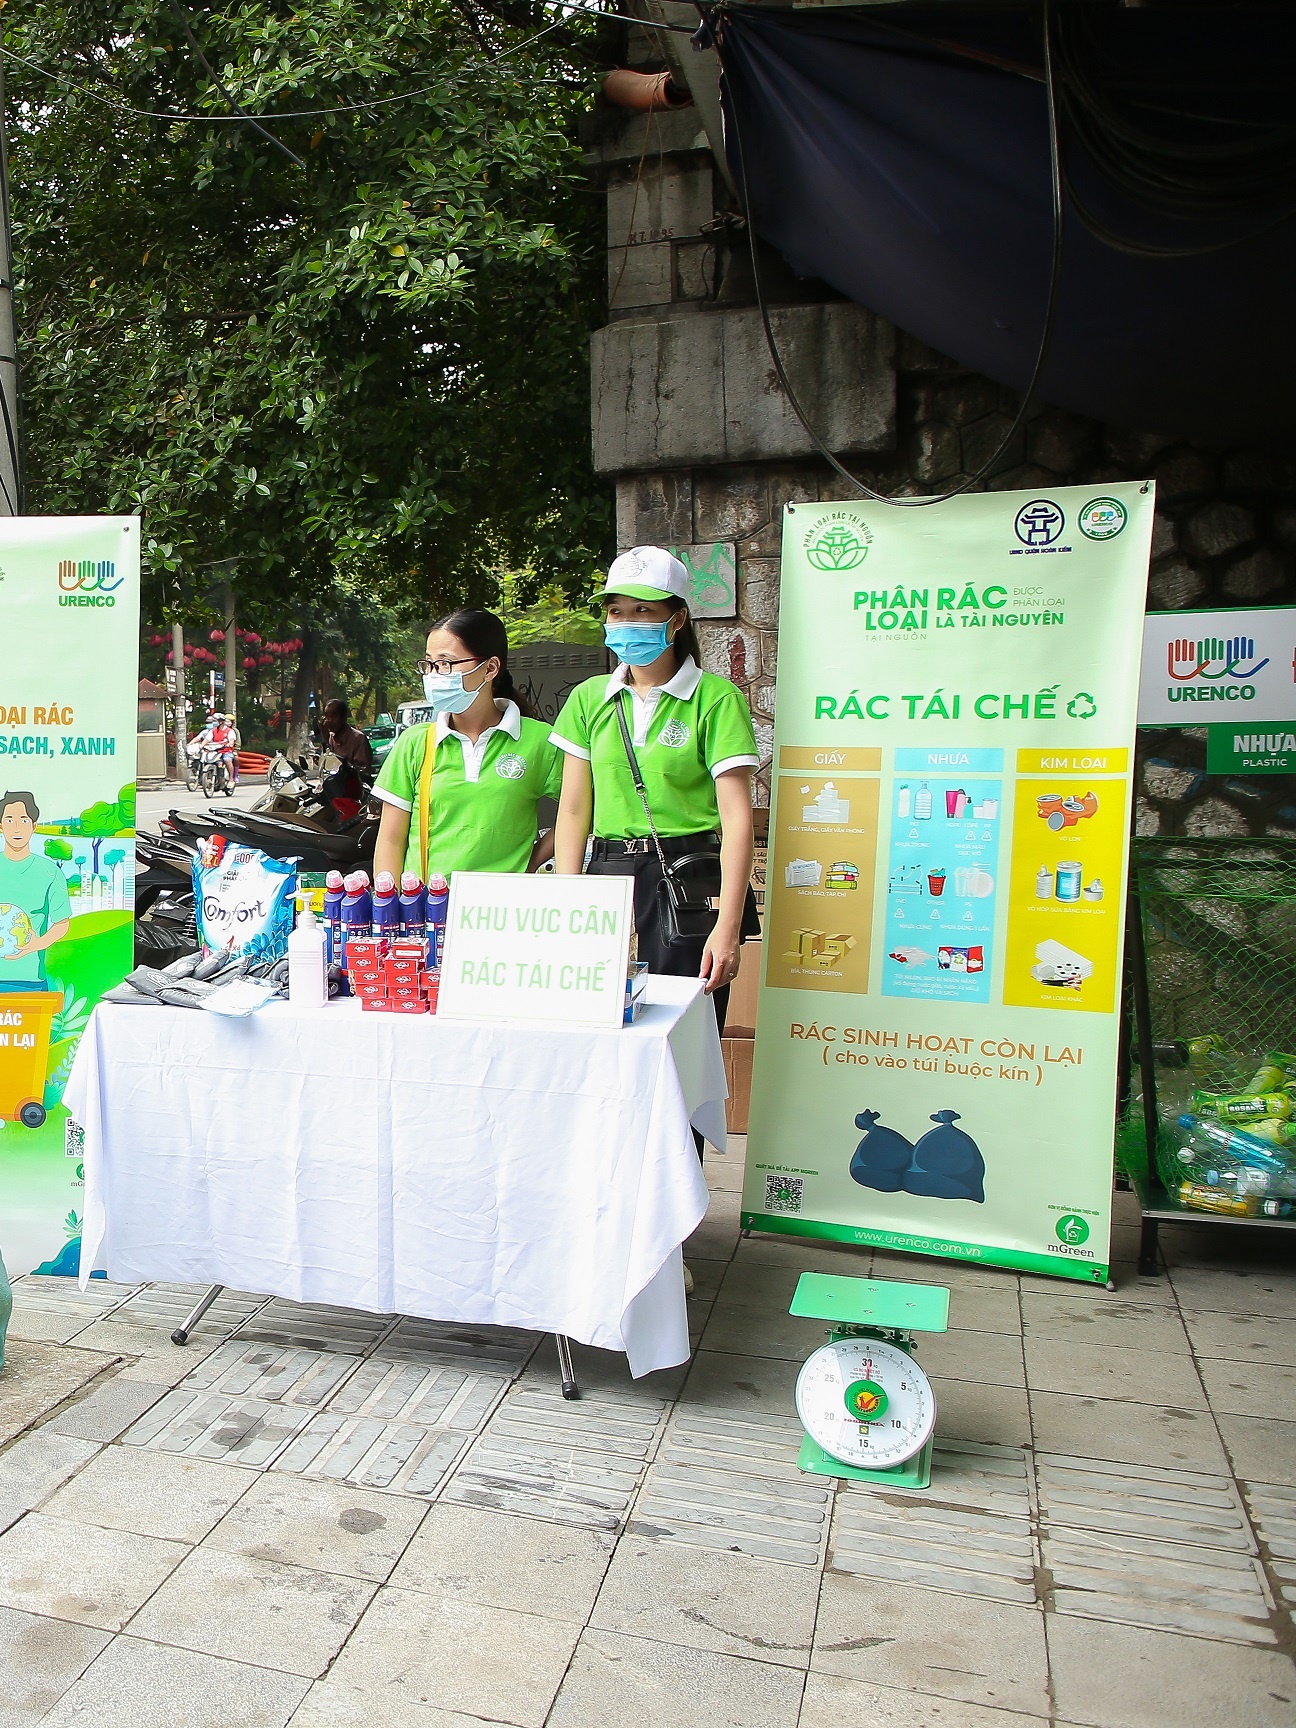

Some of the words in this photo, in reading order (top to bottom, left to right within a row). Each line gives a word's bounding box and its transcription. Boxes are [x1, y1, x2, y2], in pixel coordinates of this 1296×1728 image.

[853, 584, 929, 610] PHÂN
[936, 581, 1008, 611] RÁC
[1013, 585, 1044, 596] ĐƯỢC
[58, 595, 116, 608] URENCO
[1013, 597, 1041, 607] PHÂN
[1042, 597, 1065, 608] LOẠI
[865, 610, 928, 632] LOẠI
[935, 612, 955, 629] LÀ
[961, 612, 986, 628] TÀI
[992, 609, 1064, 627] NGUYÊN
[814, 689, 890, 720] RÁC
[901, 688, 960, 720] TÁI
[974, 684, 1061, 720] CHẾ
[1167, 684, 1256, 703] URENCO
[33, 702, 74, 725] RÁC
[60, 736, 116, 756] XANH
[1233, 732, 1296, 756] NHỰA
[814, 750, 846, 765] GIẤY
[927, 752, 970, 768] NHỰA
[1040, 756, 1068, 769] KIM
[1072, 756, 1107, 773] LOẠI
[1242, 758, 1288, 767] PLASTIC
[203, 895, 268, 931] Comfort
[459, 905, 507, 931] KHU
[515, 907, 561, 938] VỰC
[568, 904, 617, 935] CÂN
[460, 956, 507, 986] RÁC
[515, 958, 552, 989] TÁI
[559, 959, 612, 991] CHẾ
[18, 1031, 35, 1050] LẠI
[790, 1021, 837, 1043] RÁC
[842, 1027, 900, 1049] SINH
[906, 1032, 975, 1058] HOẠT
[980, 1035, 1036, 1061] CÒN
[1043, 1046, 1083, 1068] LẠI
[834, 1049, 870, 1066] cho
[874, 1051, 908, 1070] vào
[912, 1054, 939, 1073] túi
[944, 1059, 994, 1080] buộc
[999, 1062, 1030, 1081] kín
[853, 1230, 982, 1258] www.urenco.com.vn
[1047, 1244, 1095, 1258] mGreen
[824, 1374, 835, 1383] 25
[900, 1382, 907, 1391] 5
[824, 1412, 835, 1421] 20
[890, 1419, 902, 1429] 10
[859, 1439, 869, 1448] 15
